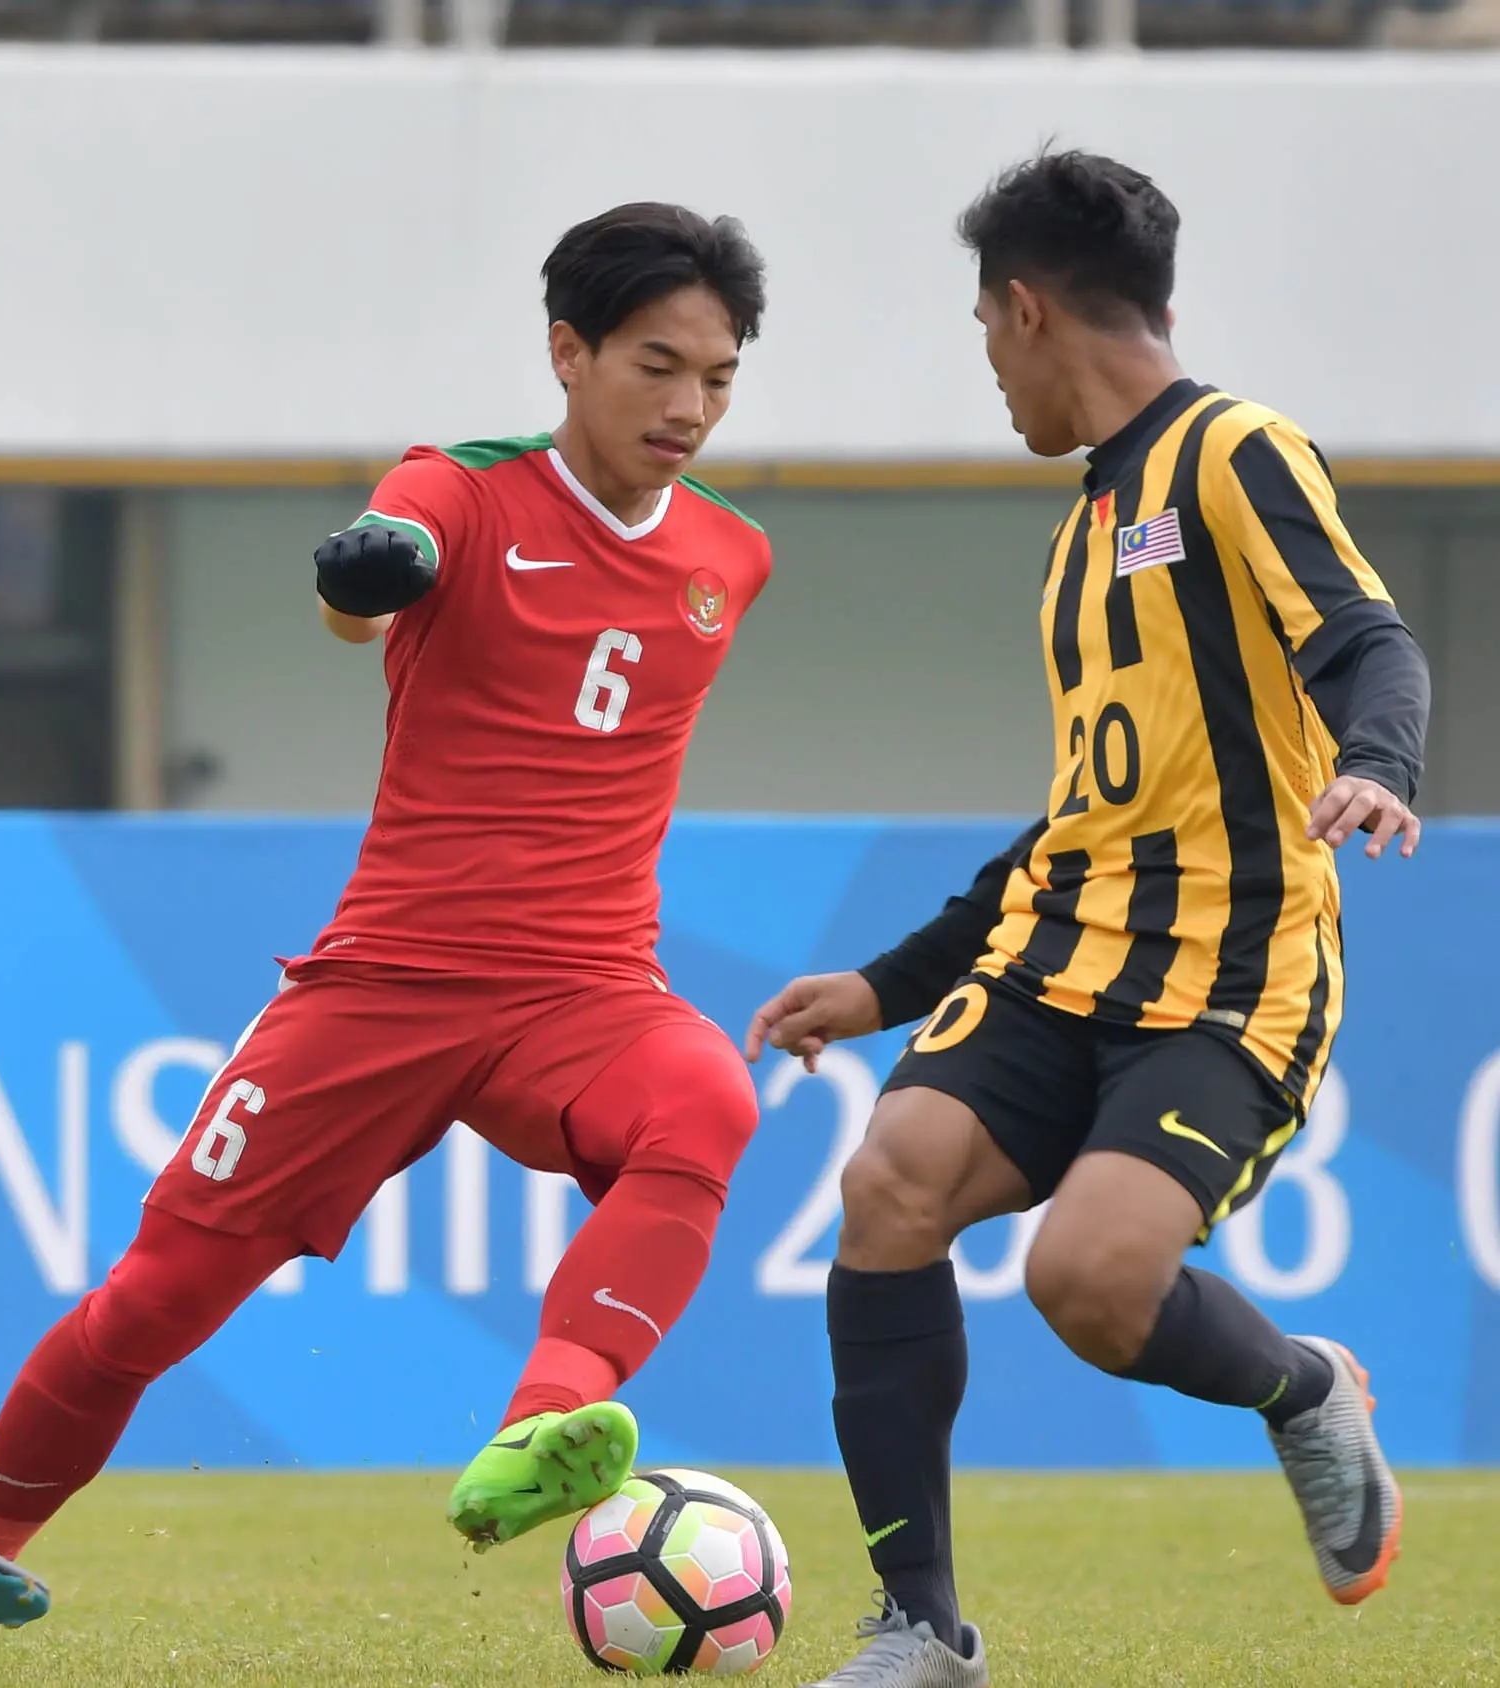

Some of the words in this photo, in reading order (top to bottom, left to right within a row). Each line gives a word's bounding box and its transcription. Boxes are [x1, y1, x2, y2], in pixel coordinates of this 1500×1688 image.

[574, 627, 643, 733] 6
[1051, 701, 1141, 820] 20
[898, 982, 989, 1061] 0
[191, 1078, 266, 1181] 6
[756, 1046, 1353, 1299] 28
